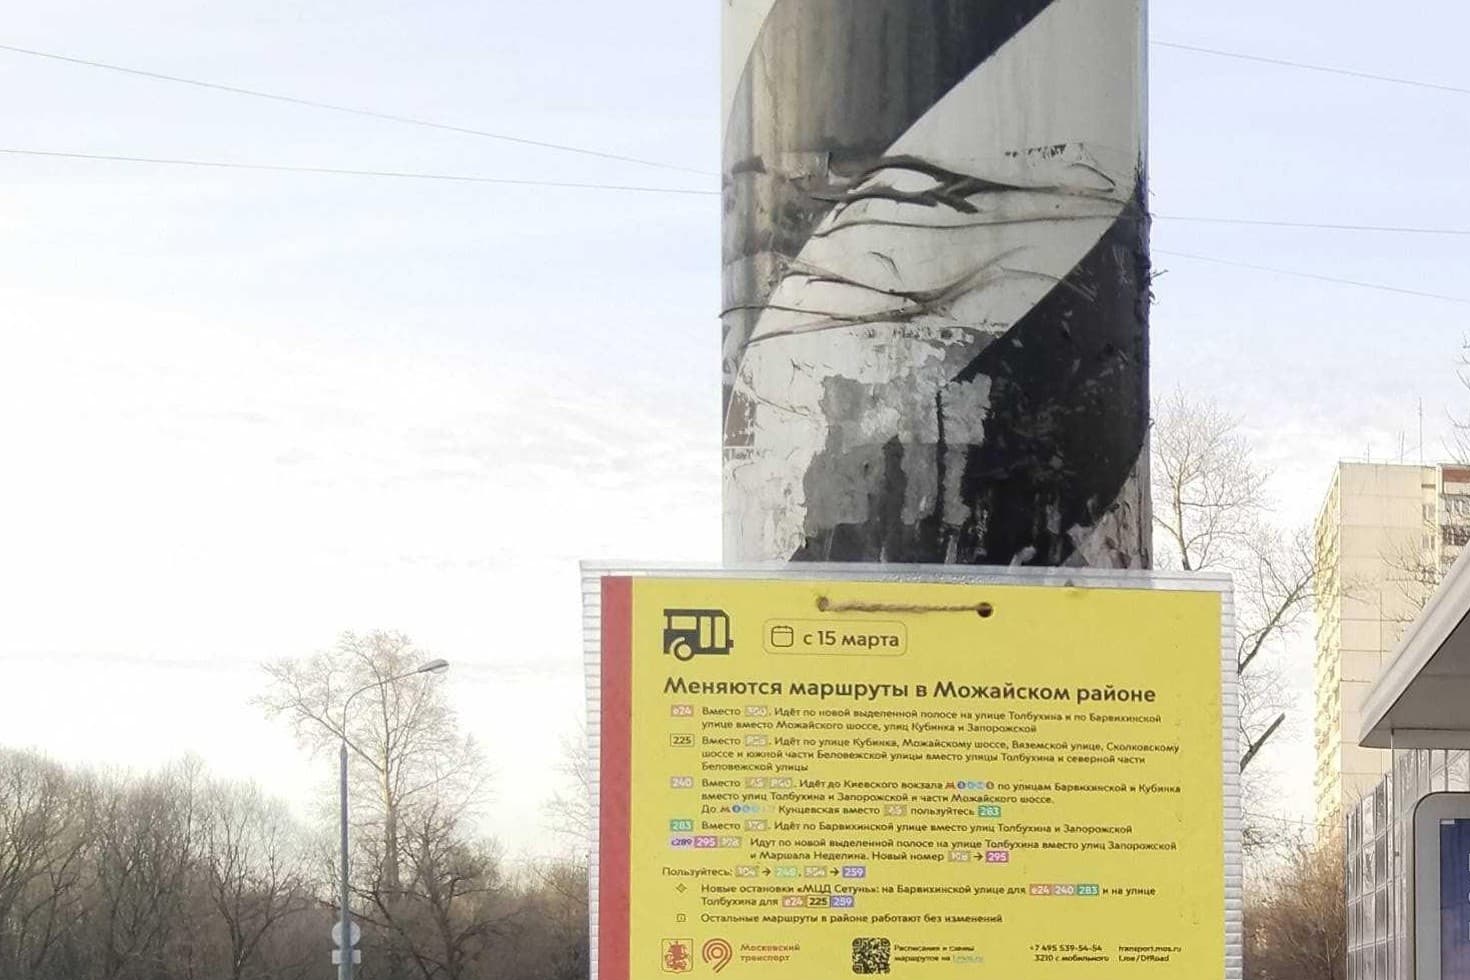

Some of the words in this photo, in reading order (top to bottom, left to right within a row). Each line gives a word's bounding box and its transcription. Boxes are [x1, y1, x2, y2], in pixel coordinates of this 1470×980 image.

[803, 633, 812, 645] с
[818, 630, 836, 646] 15
[841, 634, 899, 650] марта
[663, 676, 782, 695] Меняются
[789, 682, 908, 701] маршруты
[915, 684, 927, 697] в
[933, 680, 1070, 700] Можайском
[1077, 685, 1155, 704] районе
[702, 706, 741, 716] Вместо
[774, 707, 800, 717] Идёт
[818, 707, 850, 717] новой
[853, 708, 917, 719] выделенной
[920, 711, 957, 719] полосе
[974, 712, 1005, 722] улице
[1007, 710, 1062, 723] Толбухина
[1089, 712, 1161, 724] Барвихинской
[701, 721, 733, 730] улице
[736, 721, 773, 729] вместо
[775, 720, 843, 730] Можайского
[846, 722, 881, 731] шоссе,
[883, 723, 909, 733] улиц
[911, 721, 955, 733] Кубинка
[967, 722, 1037, 733] Запорожской
[672, 735, 692, 745] 225
[701, 735, 741, 745] Вместо
[774, 736, 800, 746] Идёт
[818, 738, 850, 748] улице
[852, 737, 899, 749] Кубинка,
[901, 738, 972, 750] Можайскому
[974, 740, 1009, 750] шоссе,
[1011, 739, 1068, 750] Вяземской
[1070, 743, 1103, 752] улице,
[1106, 741, 1179, 754] Сколковскому
[701, 750, 734, 758] шоссе
[746, 749, 782, 758] южной
[785, 751, 814, 759] части
[817, 749, 887, 760] Беловежской
[889, 752, 923, 762] улицы
[925, 753, 963, 761] вместо
[964, 753, 998, 763] улицы
[1001, 752, 1054, 764] Толбухина
[1066, 754, 1115, 765] северной
[1117, 756, 1145, 764] части
[701, 761, 773, 771] Беловежской
[774, 764, 808, 773] улицы
[701, 778, 741, 787] Вместо
[799, 779, 826, 788] Идёт
[843, 779, 898, 789] Киевского
[901, 781, 943, 789] вокзала
[1012, 783, 1051, 793] улицам
[1054, 782, 1127, 793] Барвихинской
[1138, 783, 1181, 795] Кубинка
[741, 793, 768, 803] улиц
[770, 790, 825, 803] Толбухина
[837, 791, 908, 802] Запорожской
[919, 794, 948, 802] части
[950, 793, 1017, 803] Можайского
[1019, 796, 1054, 804] шоссе.
[778, 804, 840, 816] Кунцевская
[910, 806, 975, 817] пользуйтесь
[701, 820, 740, 830] Вместо
[774, 821, 800, 831] Идёт
[818, 821, 893, 833] Барвихинской
[896, 824, 928, 833] улице
[930, 822, 968, 832] вместо
[969, 824, 995, 834] улиц
[997, 822, 1051, 835] Толбухина
[1063, 823, 1132, 835] Запорожской
[750, 837, 776, 848] Идут
[794, 838, 826, 847] новой
[829, 838, 893, 848] выделенной
[896, 840, 934, 848] полосе
[951, 841, 982, 850] улице
[984, 838, 1039, 850] Толбухина
[1080, 842, 1105, 851] улиц
[1107, 840, 1176, 851] Запорожской
[759, 850, 810, 861] Маршала
[813, 850, 869, 861] Неделина.
[871, 850, 907, 860] Новый
[910, 853, 944, 862] номер
[701, 884, 737, 893] Новые
[739, 885, 794, 895] остановки
[796, 883, 831, 895] «МЦД
[834, 883, 879, 895] Сетунь»:
[896, 884, 971, 895] Барвихинской
[973, 886, 1005, 896] улице
[1125, 887, 1156, 897] улице
[700, 896, 757, 908] Толбухина
[758, 898, 778, 907] для
[808, 897, 829, 906] 225
[700, 913, 759, 922] Остальные
[761, 915, 818, 924] маршруты
[829, 913, 868, 924] районе
[871, 912, 921, 924] работают
[923, 913, 942, 923] без
[944, 913, 1002, 923] изменений
